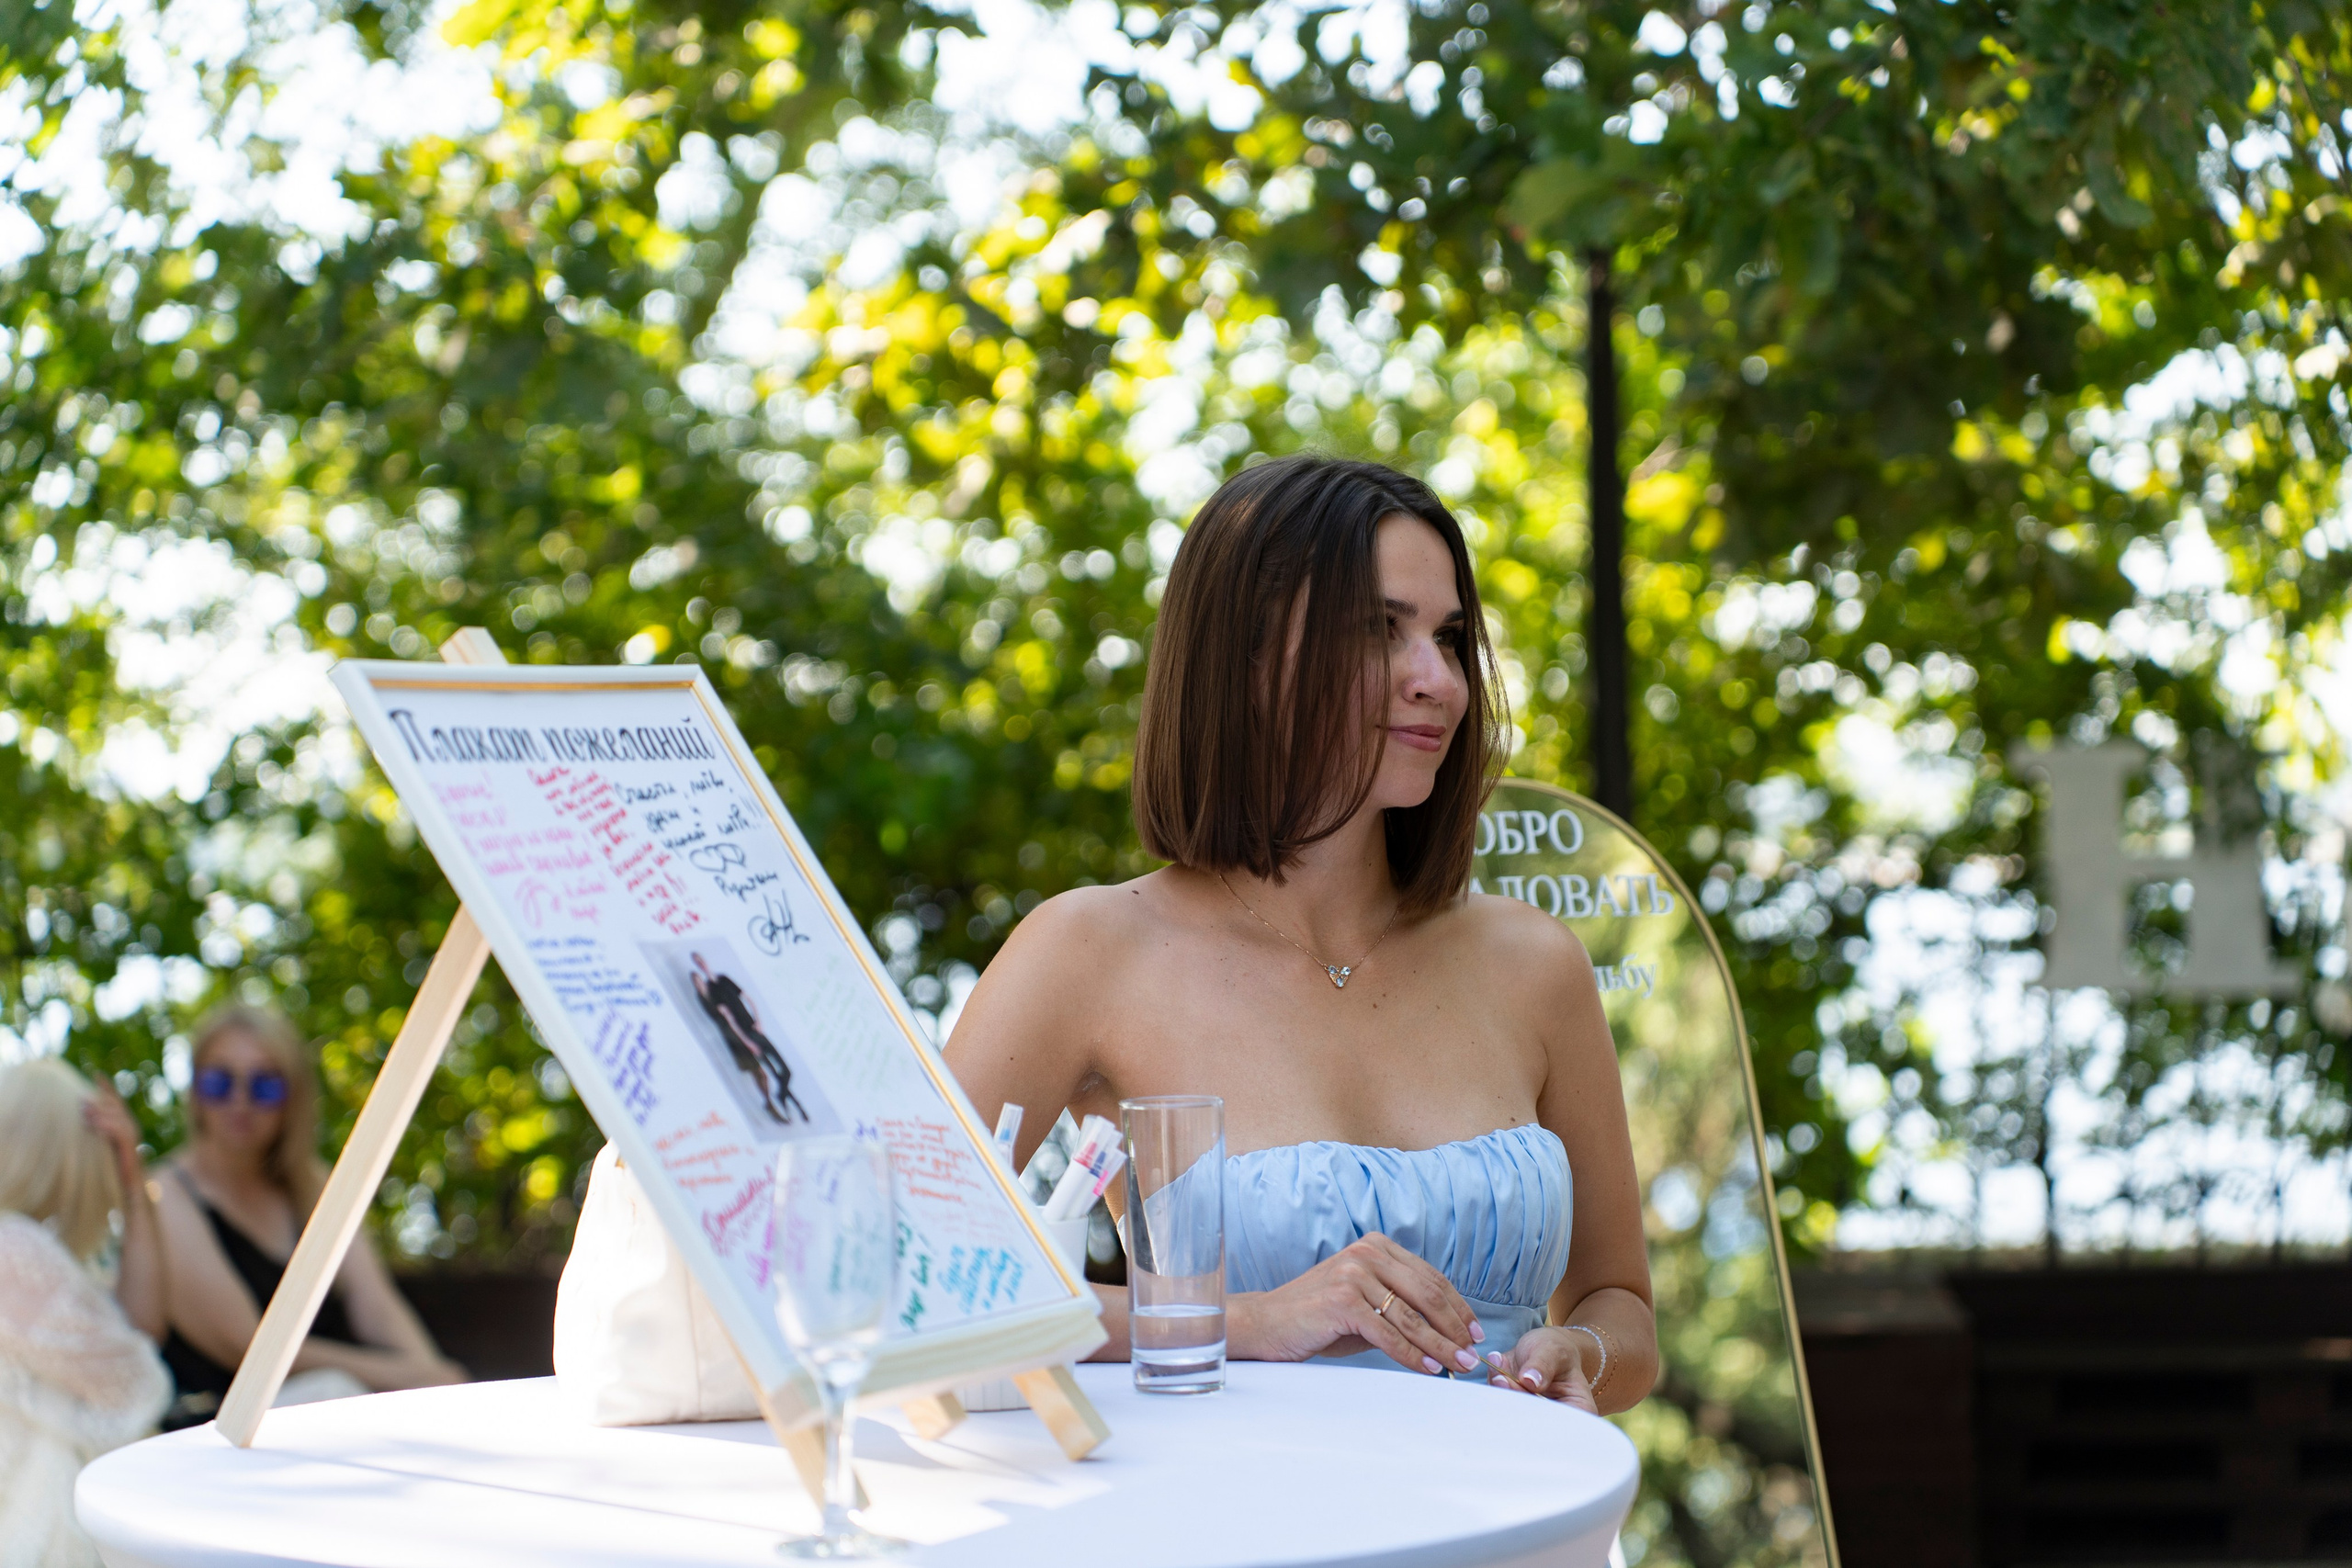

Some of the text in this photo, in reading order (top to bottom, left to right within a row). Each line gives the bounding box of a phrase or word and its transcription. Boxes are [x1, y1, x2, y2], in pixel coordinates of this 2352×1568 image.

[389, 708, 716, 763] Плакат пожеланий
[1473, 809, 1585, 856] ОБРО
[1593, 952, 1657, 1000] дьбу
